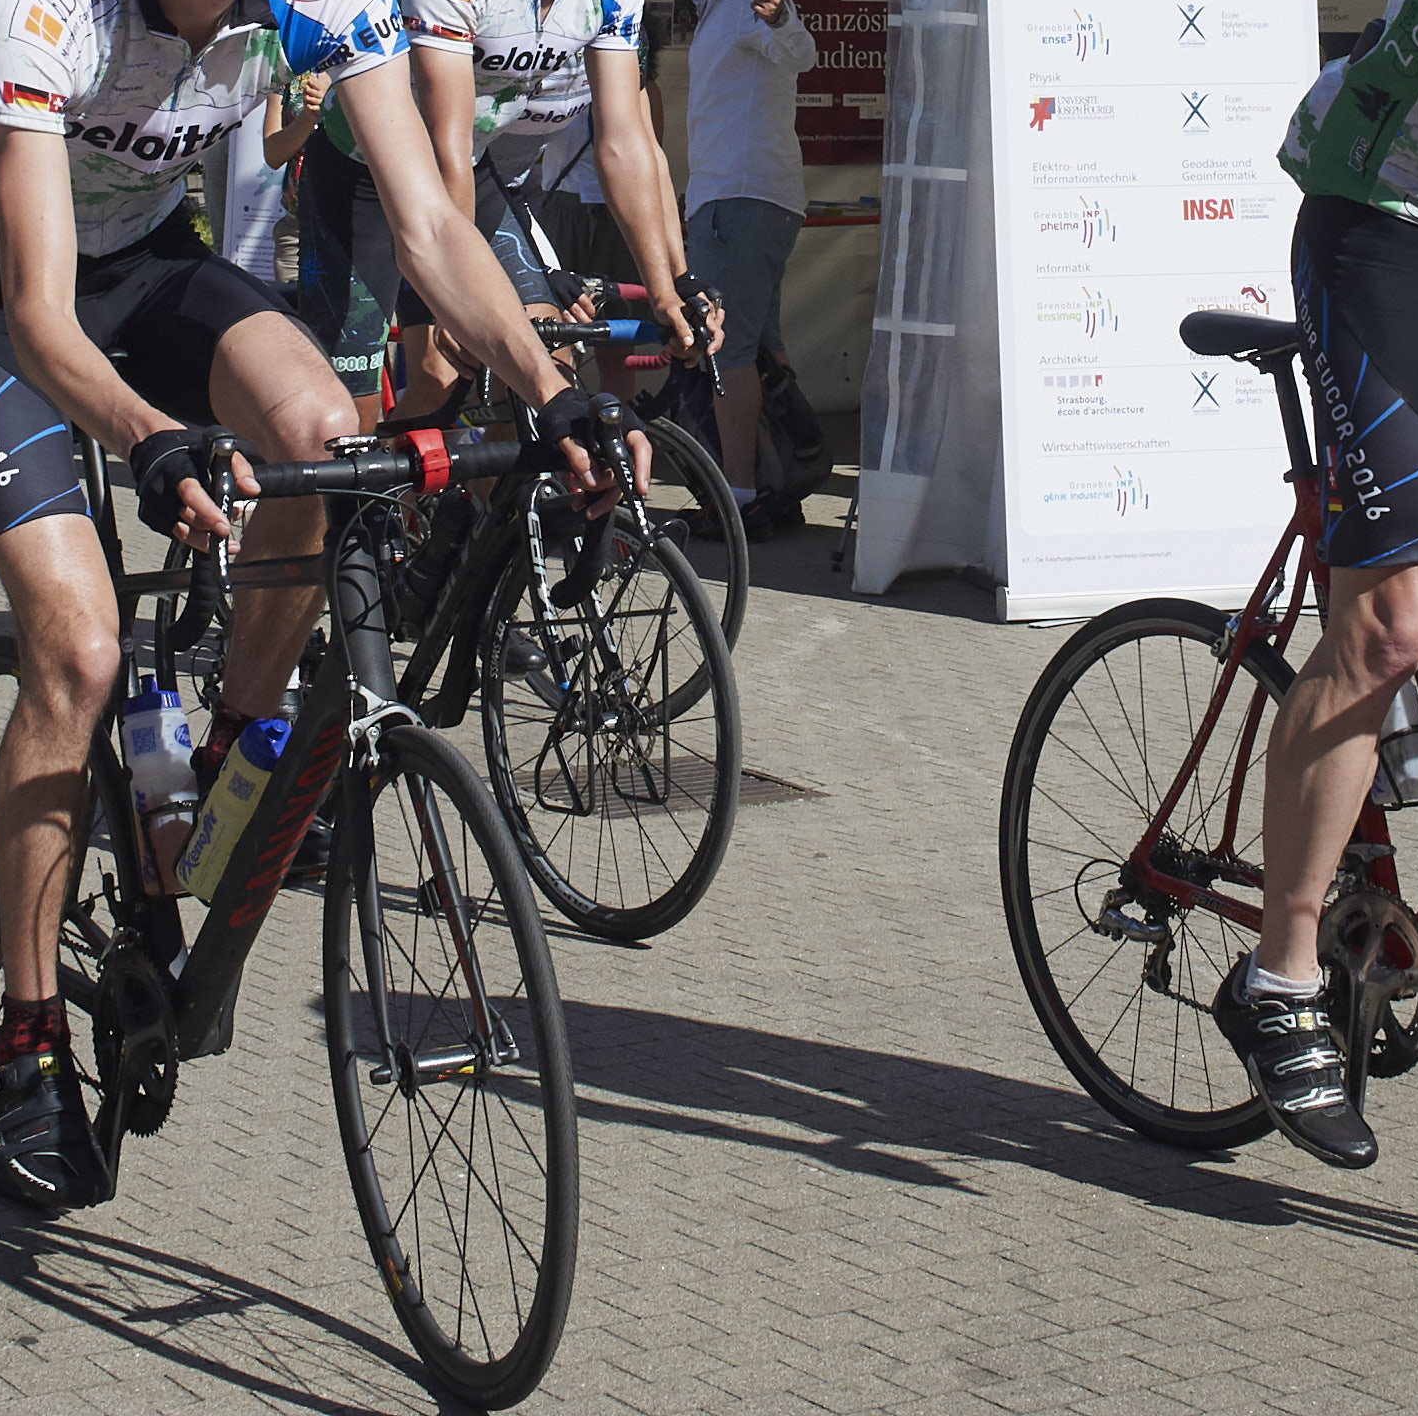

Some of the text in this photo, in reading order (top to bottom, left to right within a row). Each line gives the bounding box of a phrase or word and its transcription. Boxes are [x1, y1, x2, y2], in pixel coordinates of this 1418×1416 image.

[797, 5, 888, 33] ranzösi
[1027, 24, 1072, 32] Grenoble
[1221, 21, 1268, 30] Polytechnique
[358, 14, 404, 49] EUC
[1233, 30, 1248, 38] Paris
[816, 40, 889, 70] udien
[1029, 72, 1061, 84] Physik
[1057, 104, 1083, 115] JOSEPH
[1225, 104, 1272, 113] Polytechnique
[1033, 161, 1097, 172] Elektro- und
[1181, 158, 1252, 169] Geodäsie und
[1033, 172, 1138, 185] Informationstechnik
[1182, 170, 1257, 182] Geoinformatik
[1033, 210, 1099, 220] Grenoble INP
[1183, 199, 1234, 220] INSA
[1036, 263, 1091, 273] Informatik
[1037, 300, 1102, 310] Grenoble INP
[1037, 312, 1082, 322] ensimag
[334, 351, 385, 372] COR 20
[1039, 354, 1099, 366] Architektur
[1236, 387, 1275, 396] Polytechniq
[1056, 395, 1107, 406] Strasbourg,
[1295, 287, 1391, 523] TOUR EUCOR 2016
[1057, 405, 1145, 416] école d'architecture
[1042, 438, 1171, 453] Wirtschaftswissenschaften
[1069, 479, 1134, 489] Grenoble INP
